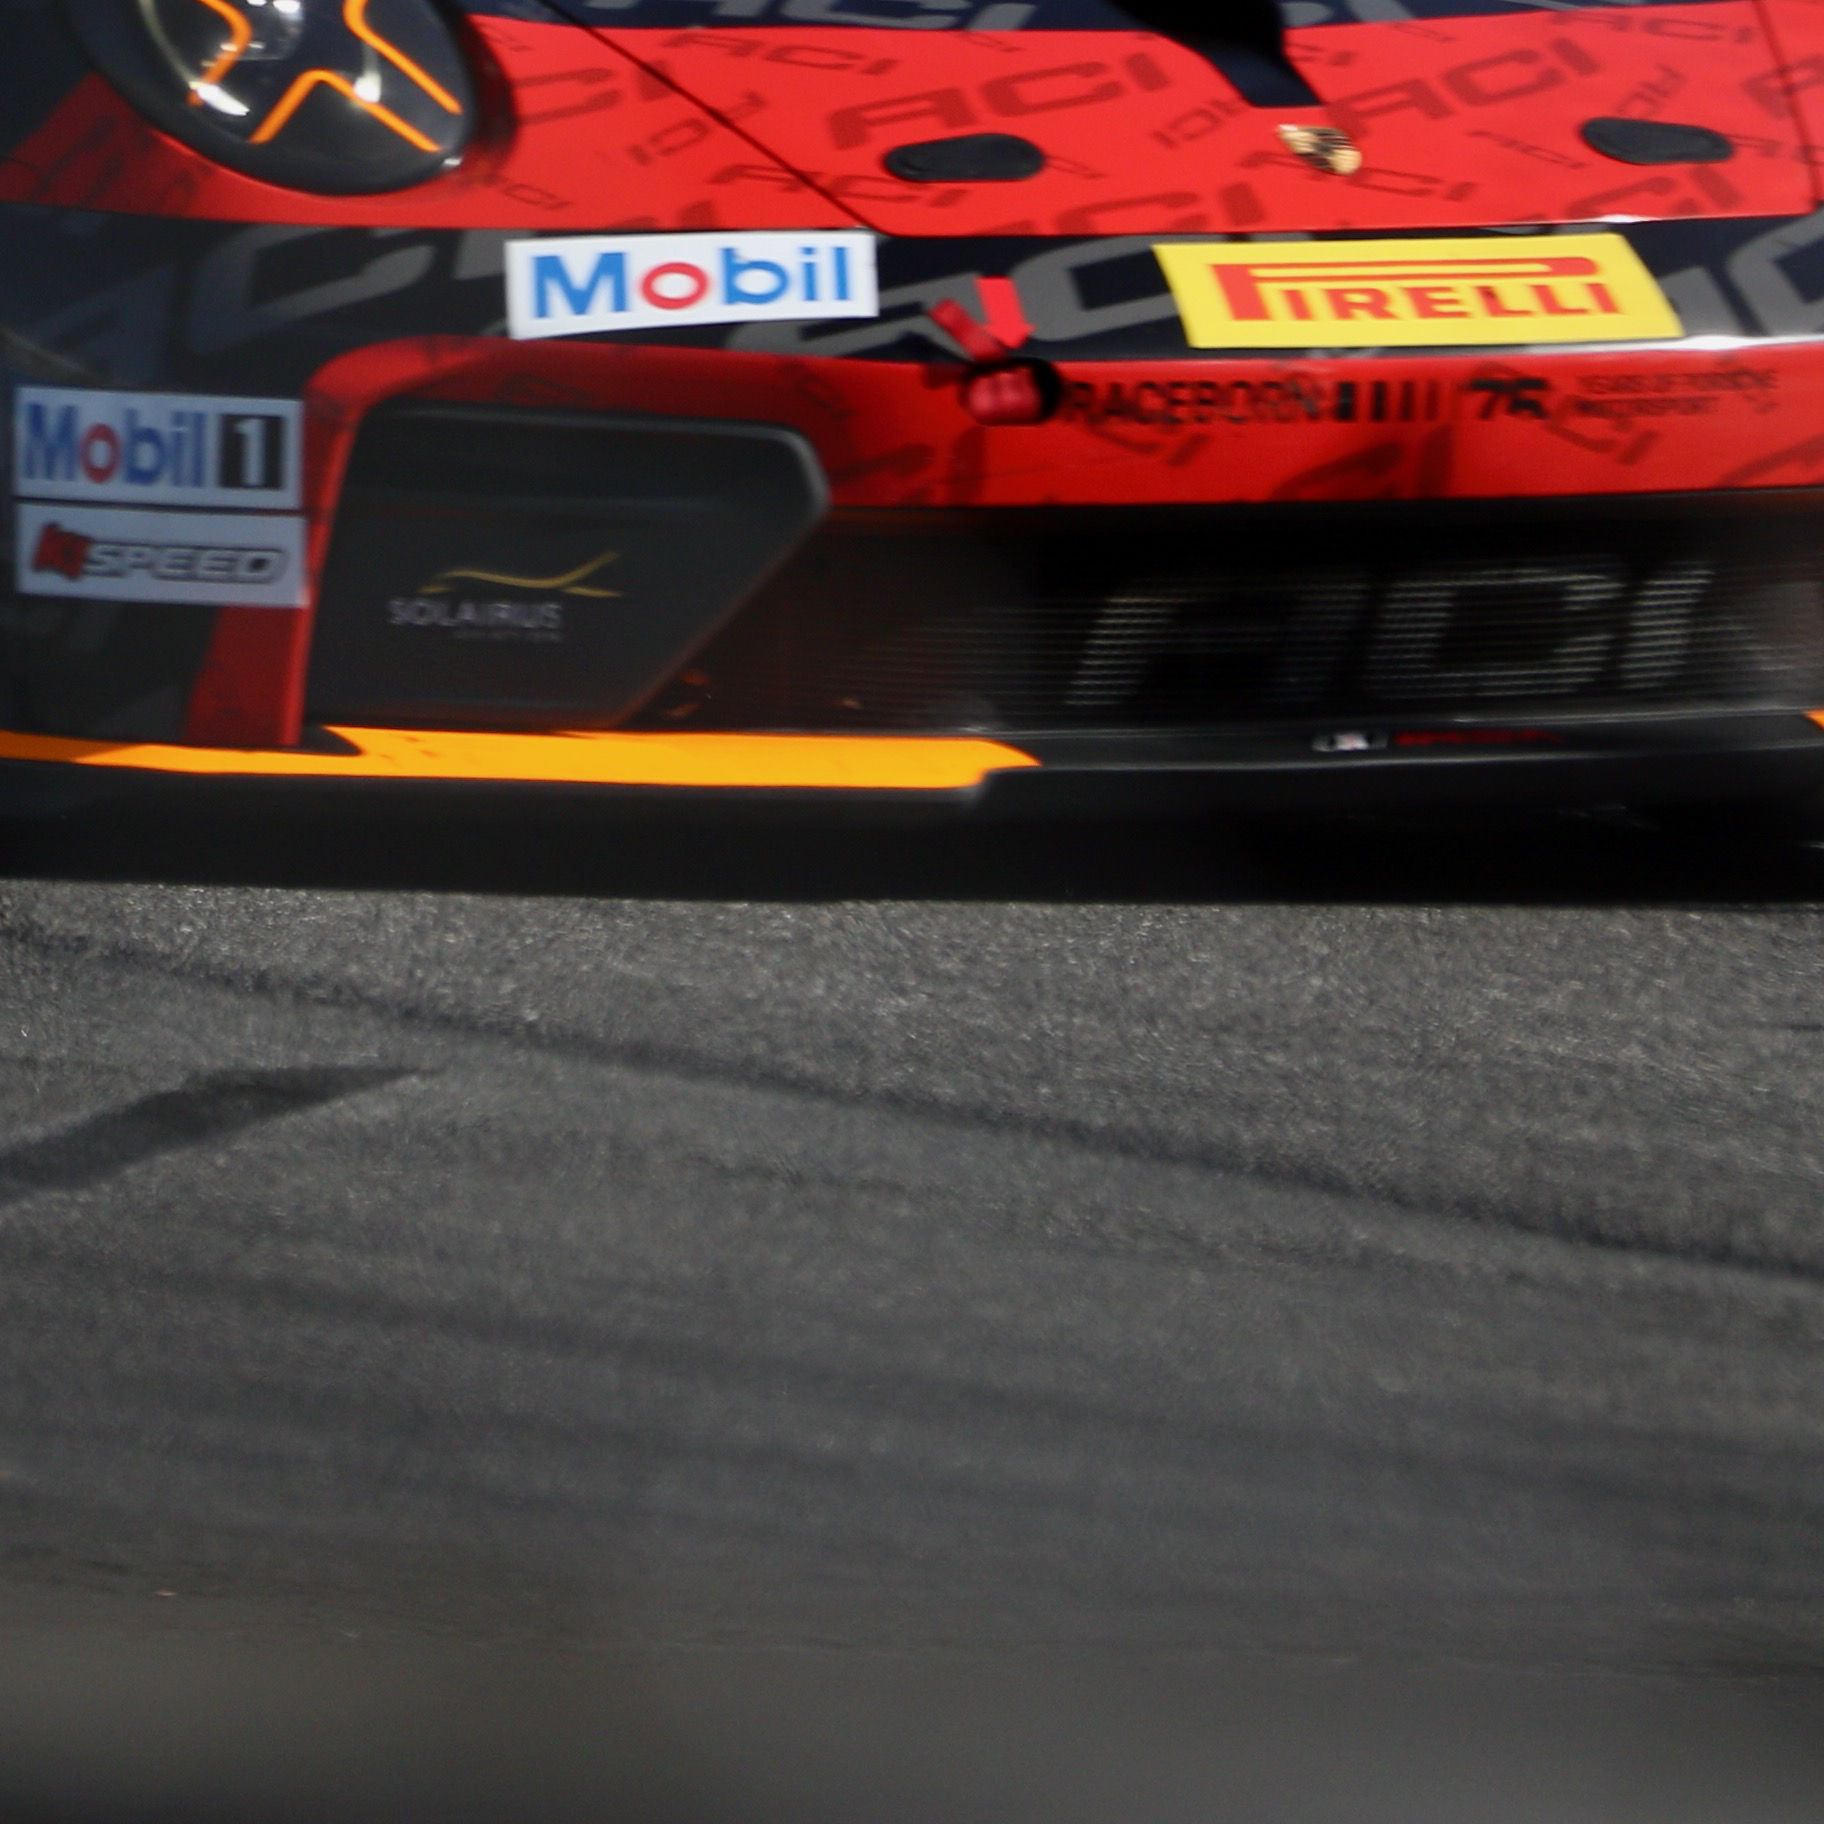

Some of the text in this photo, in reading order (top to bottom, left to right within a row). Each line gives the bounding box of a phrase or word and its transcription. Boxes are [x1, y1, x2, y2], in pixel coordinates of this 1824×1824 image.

[532, 243, 852, 318] Mobil
[1212, 255, 1624, 324] PIRELLI
[21, 402, 205, 489] Mobil
[86, 542, 285, 584] SPEED
[388, 596, 563, 630] SOLAIRUS
